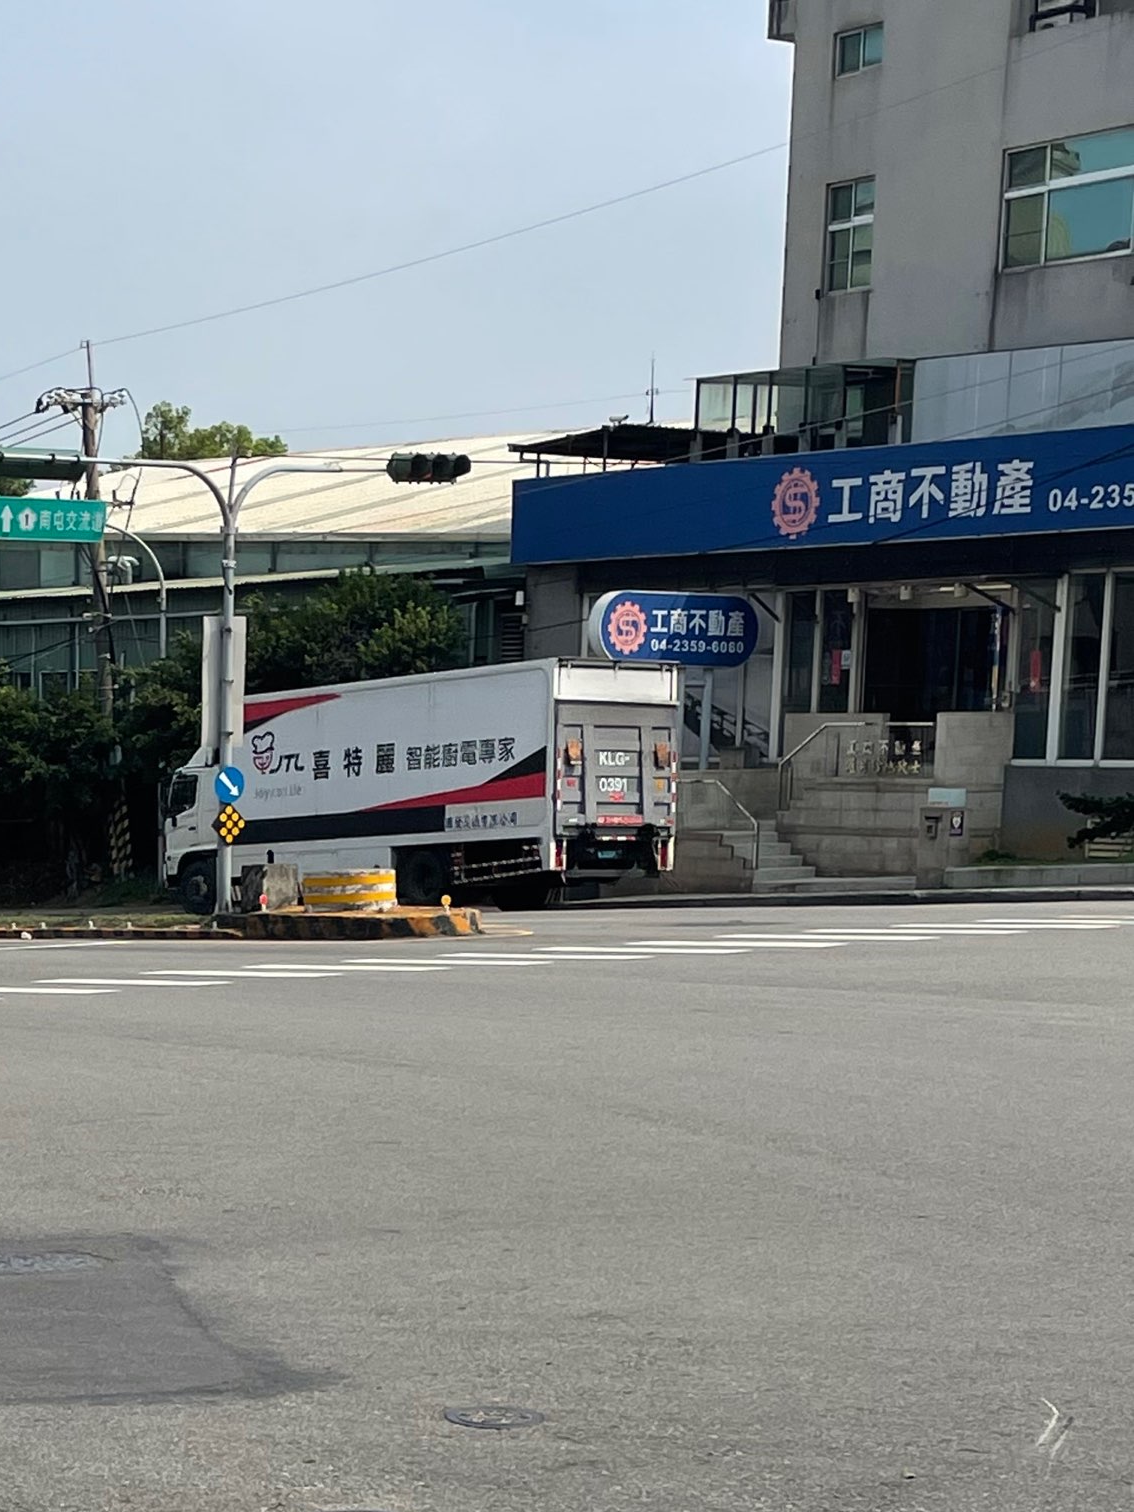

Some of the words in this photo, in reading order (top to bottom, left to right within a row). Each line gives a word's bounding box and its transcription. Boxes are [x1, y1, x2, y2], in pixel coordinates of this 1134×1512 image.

[826, 458, 1035, 524] 工商不動產
[1048, 480, 1134, 513] 04-235
[39, 509, 104, 533] 南屯交流道
[650, 608, 745, 637] 工商不動產
[312, 742, 396, 781] 喜特麗
[406, 736, 516, 772] 智能廚電專家
[598, 777, 628, 793] 0391
